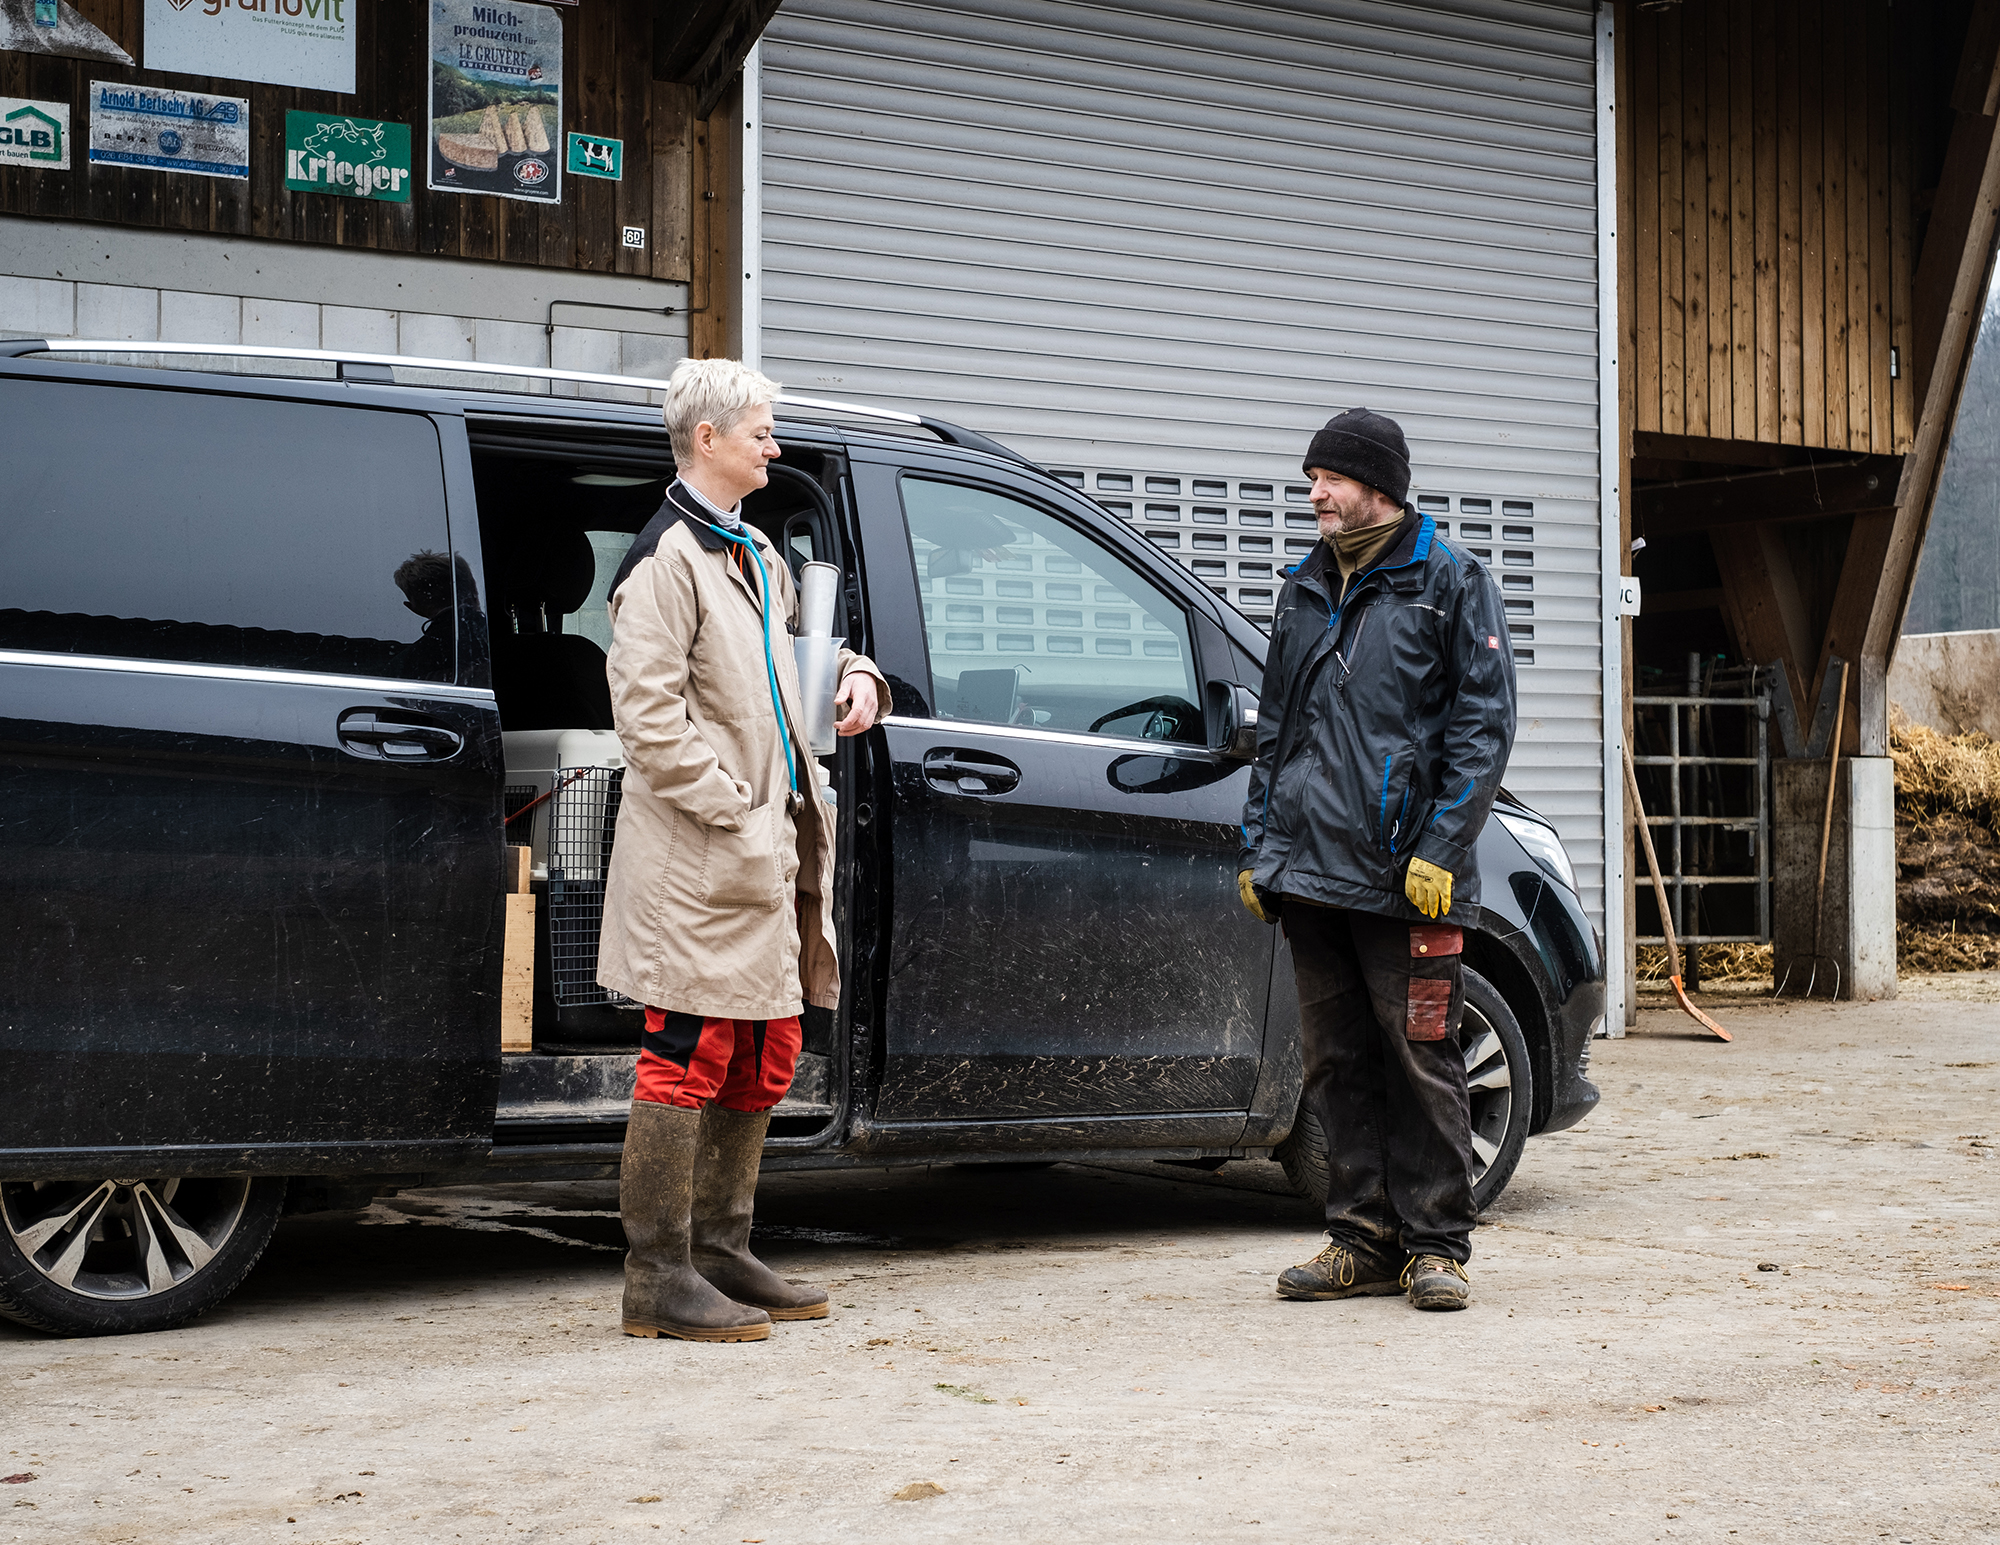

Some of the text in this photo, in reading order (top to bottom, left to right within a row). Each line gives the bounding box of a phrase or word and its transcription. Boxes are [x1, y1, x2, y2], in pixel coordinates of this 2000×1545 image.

[252, 15, 263, 23] Das
[264, 17, 304, 28] Futterkonzept
[472, 6, 523, 27] Milch-
[281, 27, 296, 35] PLUS
[320, 32, 345, 41] aliments
[454, 24, 538, 46] produzent für
[459, 43, 528, 67] LE GRUYÈRE
[462, 61, 525, 75] SWITZERLAND
[100, 88, 204, 117] Arnold Bertschy AG
[0, 126, 51, 148] GLB
[104, 132, 148, 144] BERA
[6, 149, 29, 158] bauen
[100, 151, 116, 160] 026
[118, 153, 133, 162] 684
[135, 155, 145, 163] 34
[287, 149, 408, 196] Krieger
[1619, 588, 1633, 604] C
